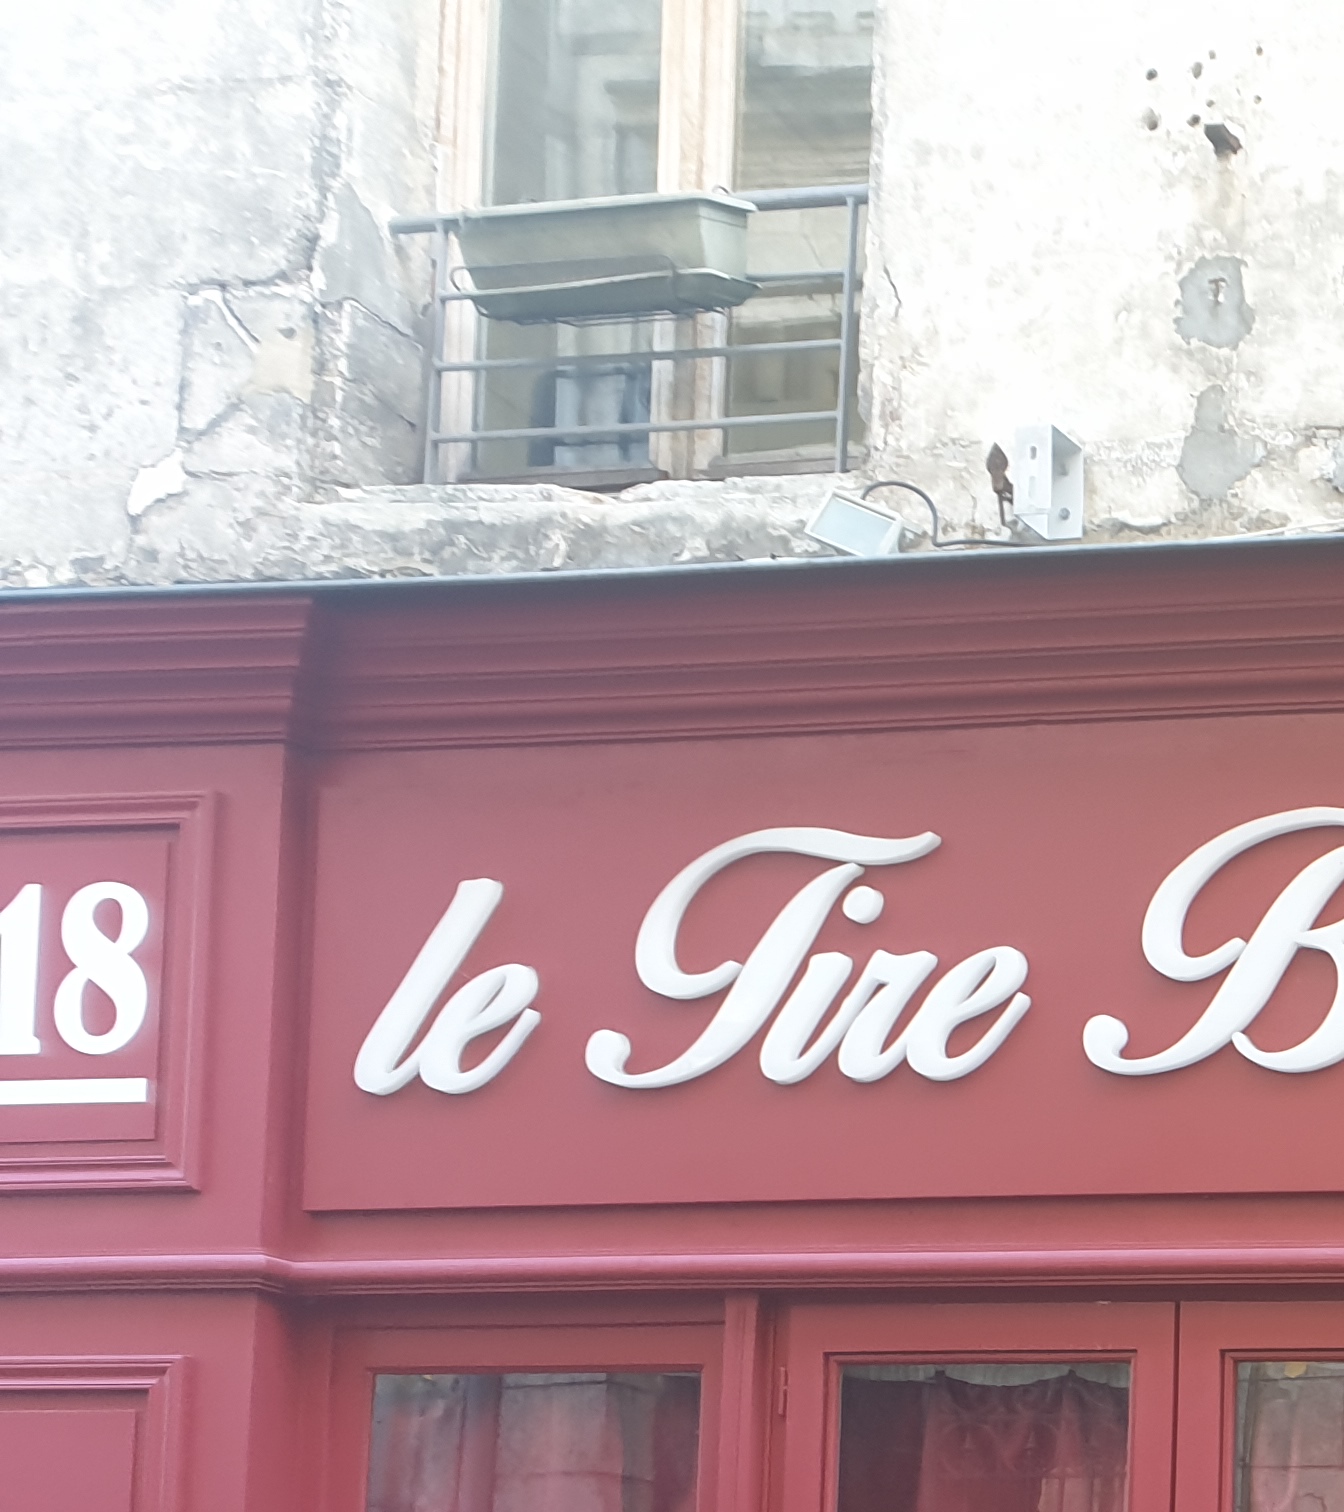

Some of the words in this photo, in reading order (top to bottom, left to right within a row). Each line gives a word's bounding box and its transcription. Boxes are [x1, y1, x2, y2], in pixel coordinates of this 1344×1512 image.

[0, 881, 150, 1055] 18
[353, 877, 541, 1097] le
[584, 826, 1032, 1090] Tire
